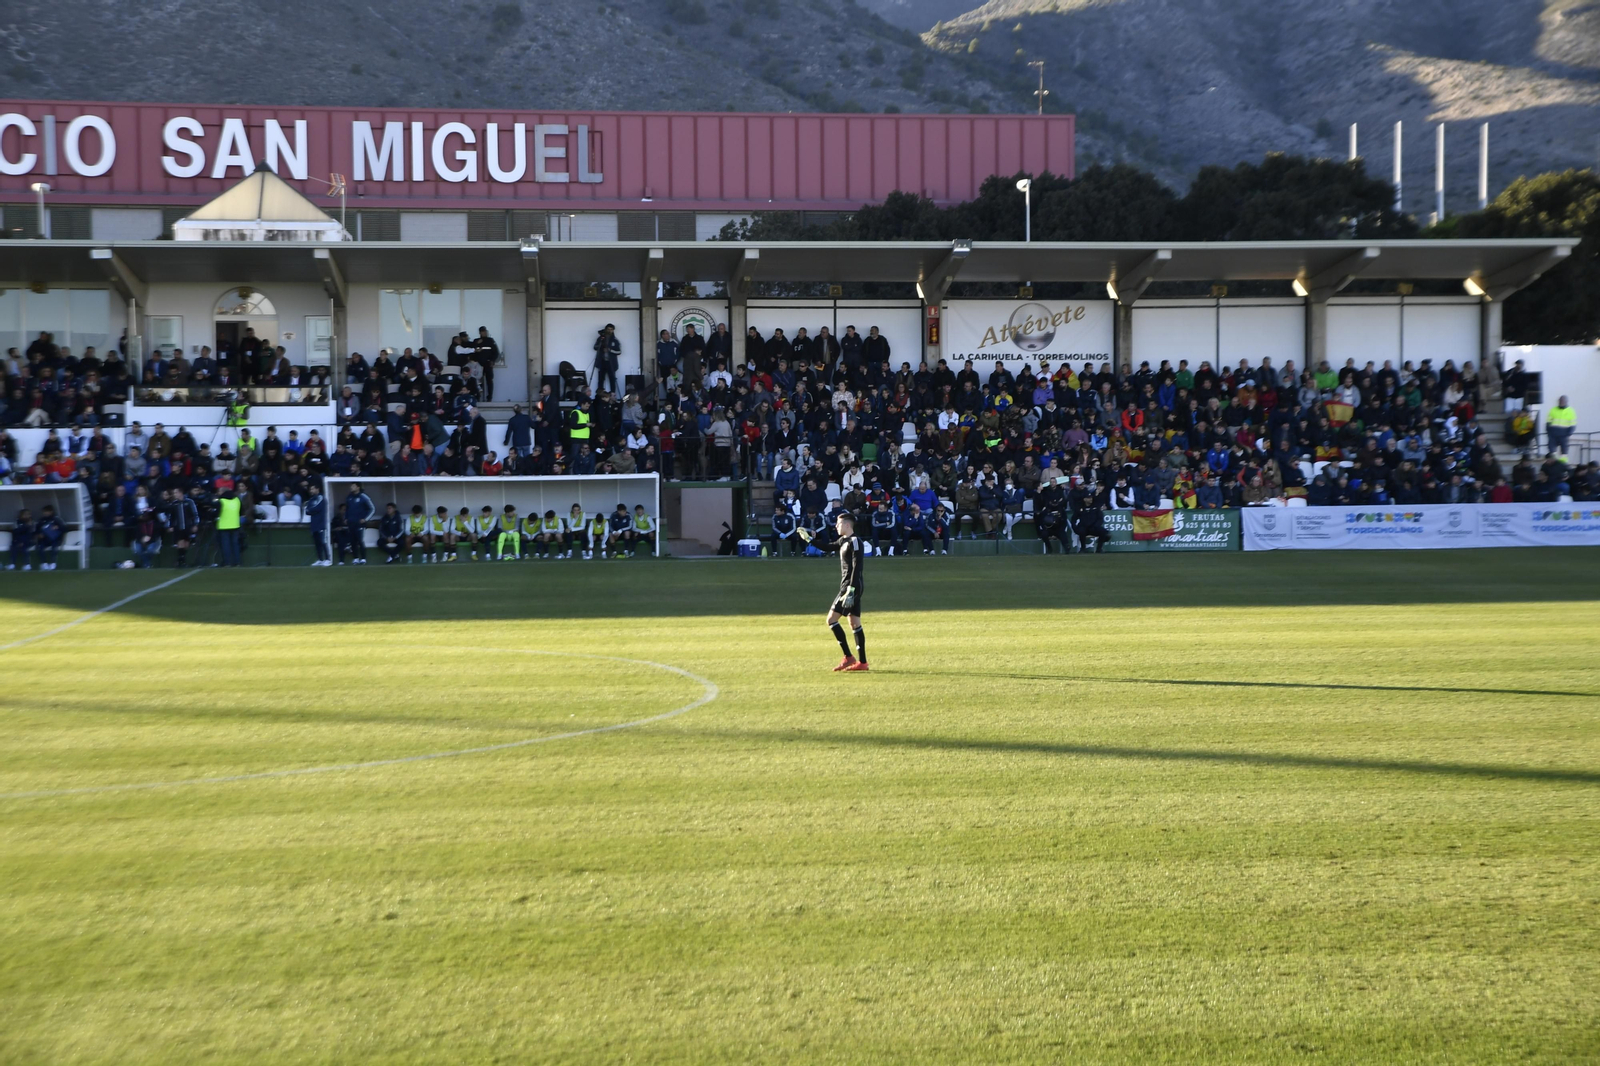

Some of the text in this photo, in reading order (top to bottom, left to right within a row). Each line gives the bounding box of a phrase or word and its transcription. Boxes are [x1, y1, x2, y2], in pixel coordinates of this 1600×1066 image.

[162, 116, 308, 180] SAN
[352, 121, 604, 184] MIGUEL
[977, 305, 1086, 349] Atrévete
[967, 353, 1023, 361] CARIHUELA
[1032, 353, 1109, 361] TORREMOLINOS
[1103, 514, 1128, 523] OTEL
[1103, 523, 1134, 531] ESPAD
[1185, 521, 1199, 529] 625
[1346, 526, 1424, 534] TORREMOLINOS
